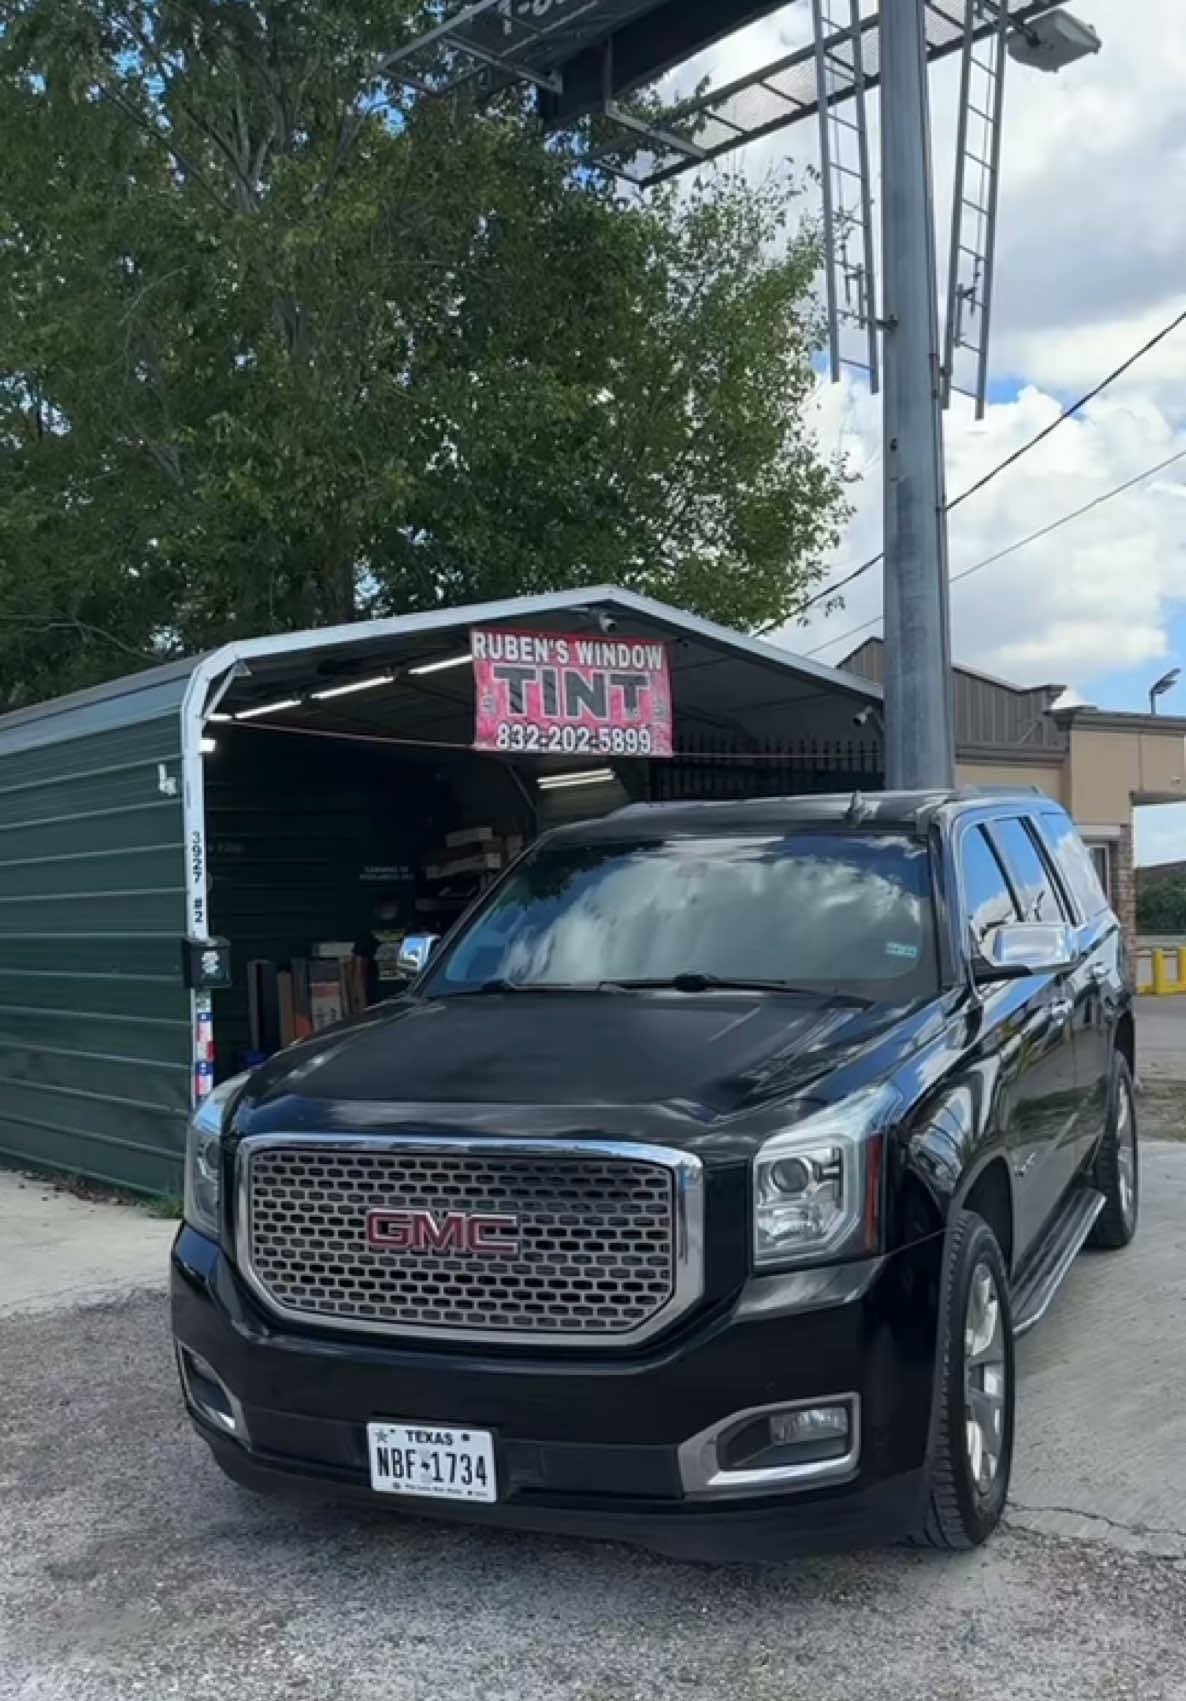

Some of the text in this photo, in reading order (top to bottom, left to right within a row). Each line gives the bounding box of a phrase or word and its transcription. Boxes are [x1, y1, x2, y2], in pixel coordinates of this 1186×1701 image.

[472, 631, 664, 670] RUBEN'S WINDOW
[491, 662, 650, 721] TINT
[366, 1207, 519, 1256] GMC
[405, 1429, 454, 1446] TEXAS
